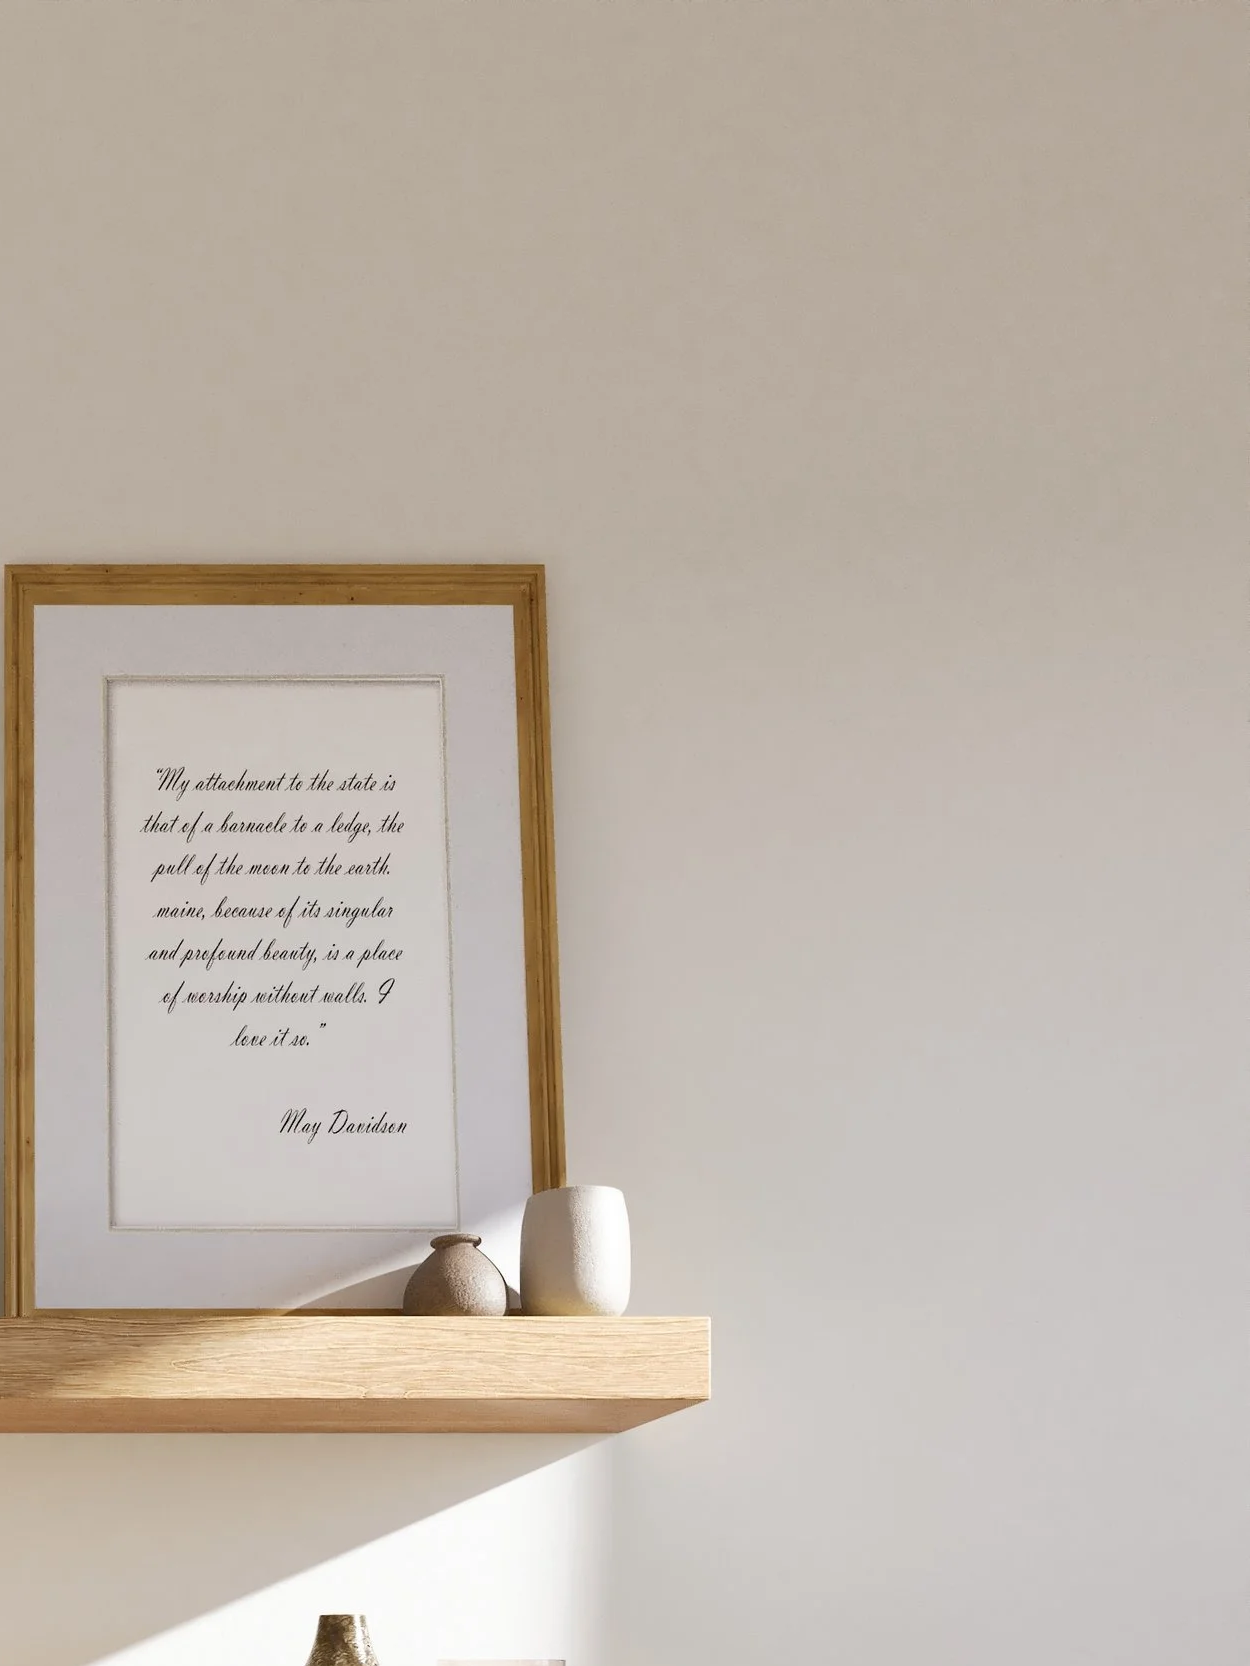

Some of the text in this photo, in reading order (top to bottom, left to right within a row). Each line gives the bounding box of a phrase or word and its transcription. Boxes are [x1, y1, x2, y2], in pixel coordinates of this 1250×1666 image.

[192, 769, 285, 791] attachment
[285, 773, 302, 791] to
[307, 769, 333, 791] the
[337, 772, 377, 791] state
[380, 775, 396, 791] is
[139, 811, 405, 843] that of a barnacle to a ledge, the
[150, 853, 390, 885] pull of the moon to the earth.
[152, 896, 394, 928] maine, because of its singular
[145, 938, 403, 970] and profound beauty, is a place
[158, 978, 395, 1014] of worship without walls. I
[230, 1025, 267, 1047] love
[269, 1029, 290, 1047] it
[279, 1108, 407, 1144] May Davidson
